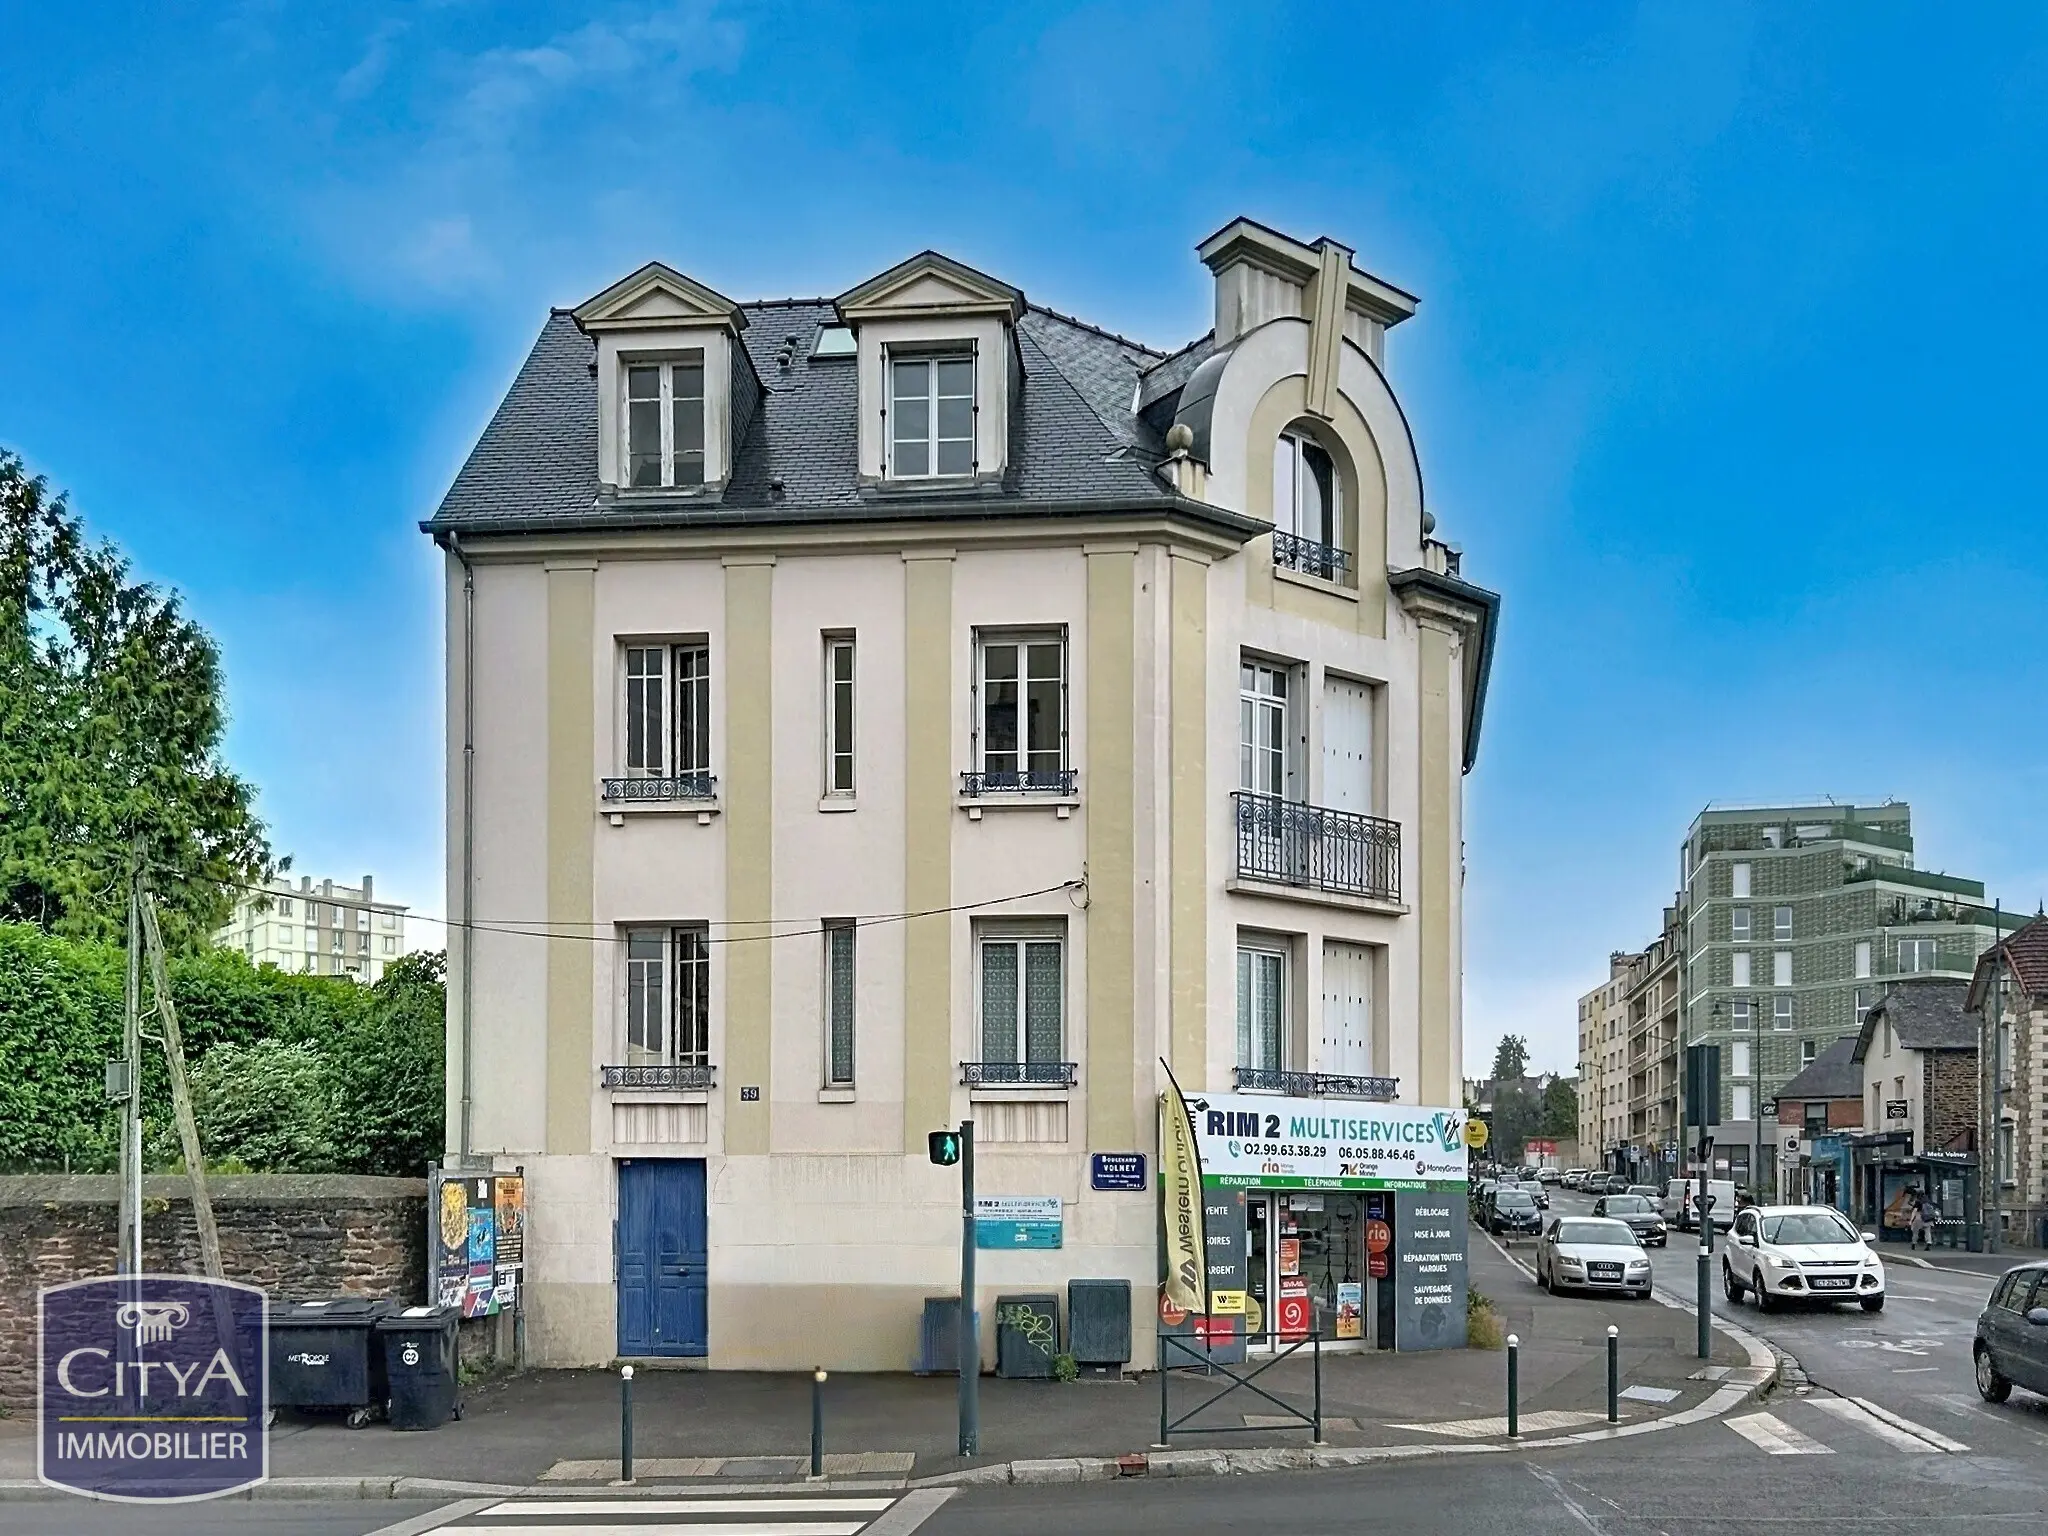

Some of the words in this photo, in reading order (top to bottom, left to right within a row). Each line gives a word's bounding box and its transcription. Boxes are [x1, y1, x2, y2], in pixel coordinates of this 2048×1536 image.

[1207, 1110, 1259, 1138] RIM
[1264, 1114, 1281, 1139] 2
[1290, 1116, 1434, 1144] MULTISERVICES
[1244, 1143, 1327, 1158] 02.99.63.38.29
[1338, 1146, 1415, 1161] 06.05.88.46.46
[1945, 1151, 1968, 1159] Volney
[1103, 1164, 1136, 1172] VOLNEY
[1261, 1157, 1280, 1173] ria
[1359, 1162, 1378, 1170] Orange
[1426, 1164, 1463, 1173] MoneyGram
[1359, 1169, 1377, 1177] Money
[1219, 1174, 1261, 1186] RÉPARATION
[1304, 1177, 1343, 1188] TÉLÉPHONIE
[1383, 1181, 1427, 1189] INFORMATIQUE
[1415, 1206, 1450, 1217] DÉBLOCAGE
[1368, 1223, 1388, 1240] ria
[1414, 1230, 1429, 1239] MISE
[1430, 1228, 1435, 1239] À
[1435, 1230, 1451, 1238] JOUR
[1206, 1236, 1231, 1246] SOIRES
[1403, 1252, 1440, 1263] RÉPARATION
[1441, 1253, 1463, 1262] TOUTES
[1419, 1264, 1448, 1273] MARQUES
[1413, 1284, 1453, 1294] SAUVEGARDE
[1414, 1296, 1423, 1305] DE
[1423, 1294, 1452, 1304] DONNÉES
[404, 1352, 418, 1362] C2
